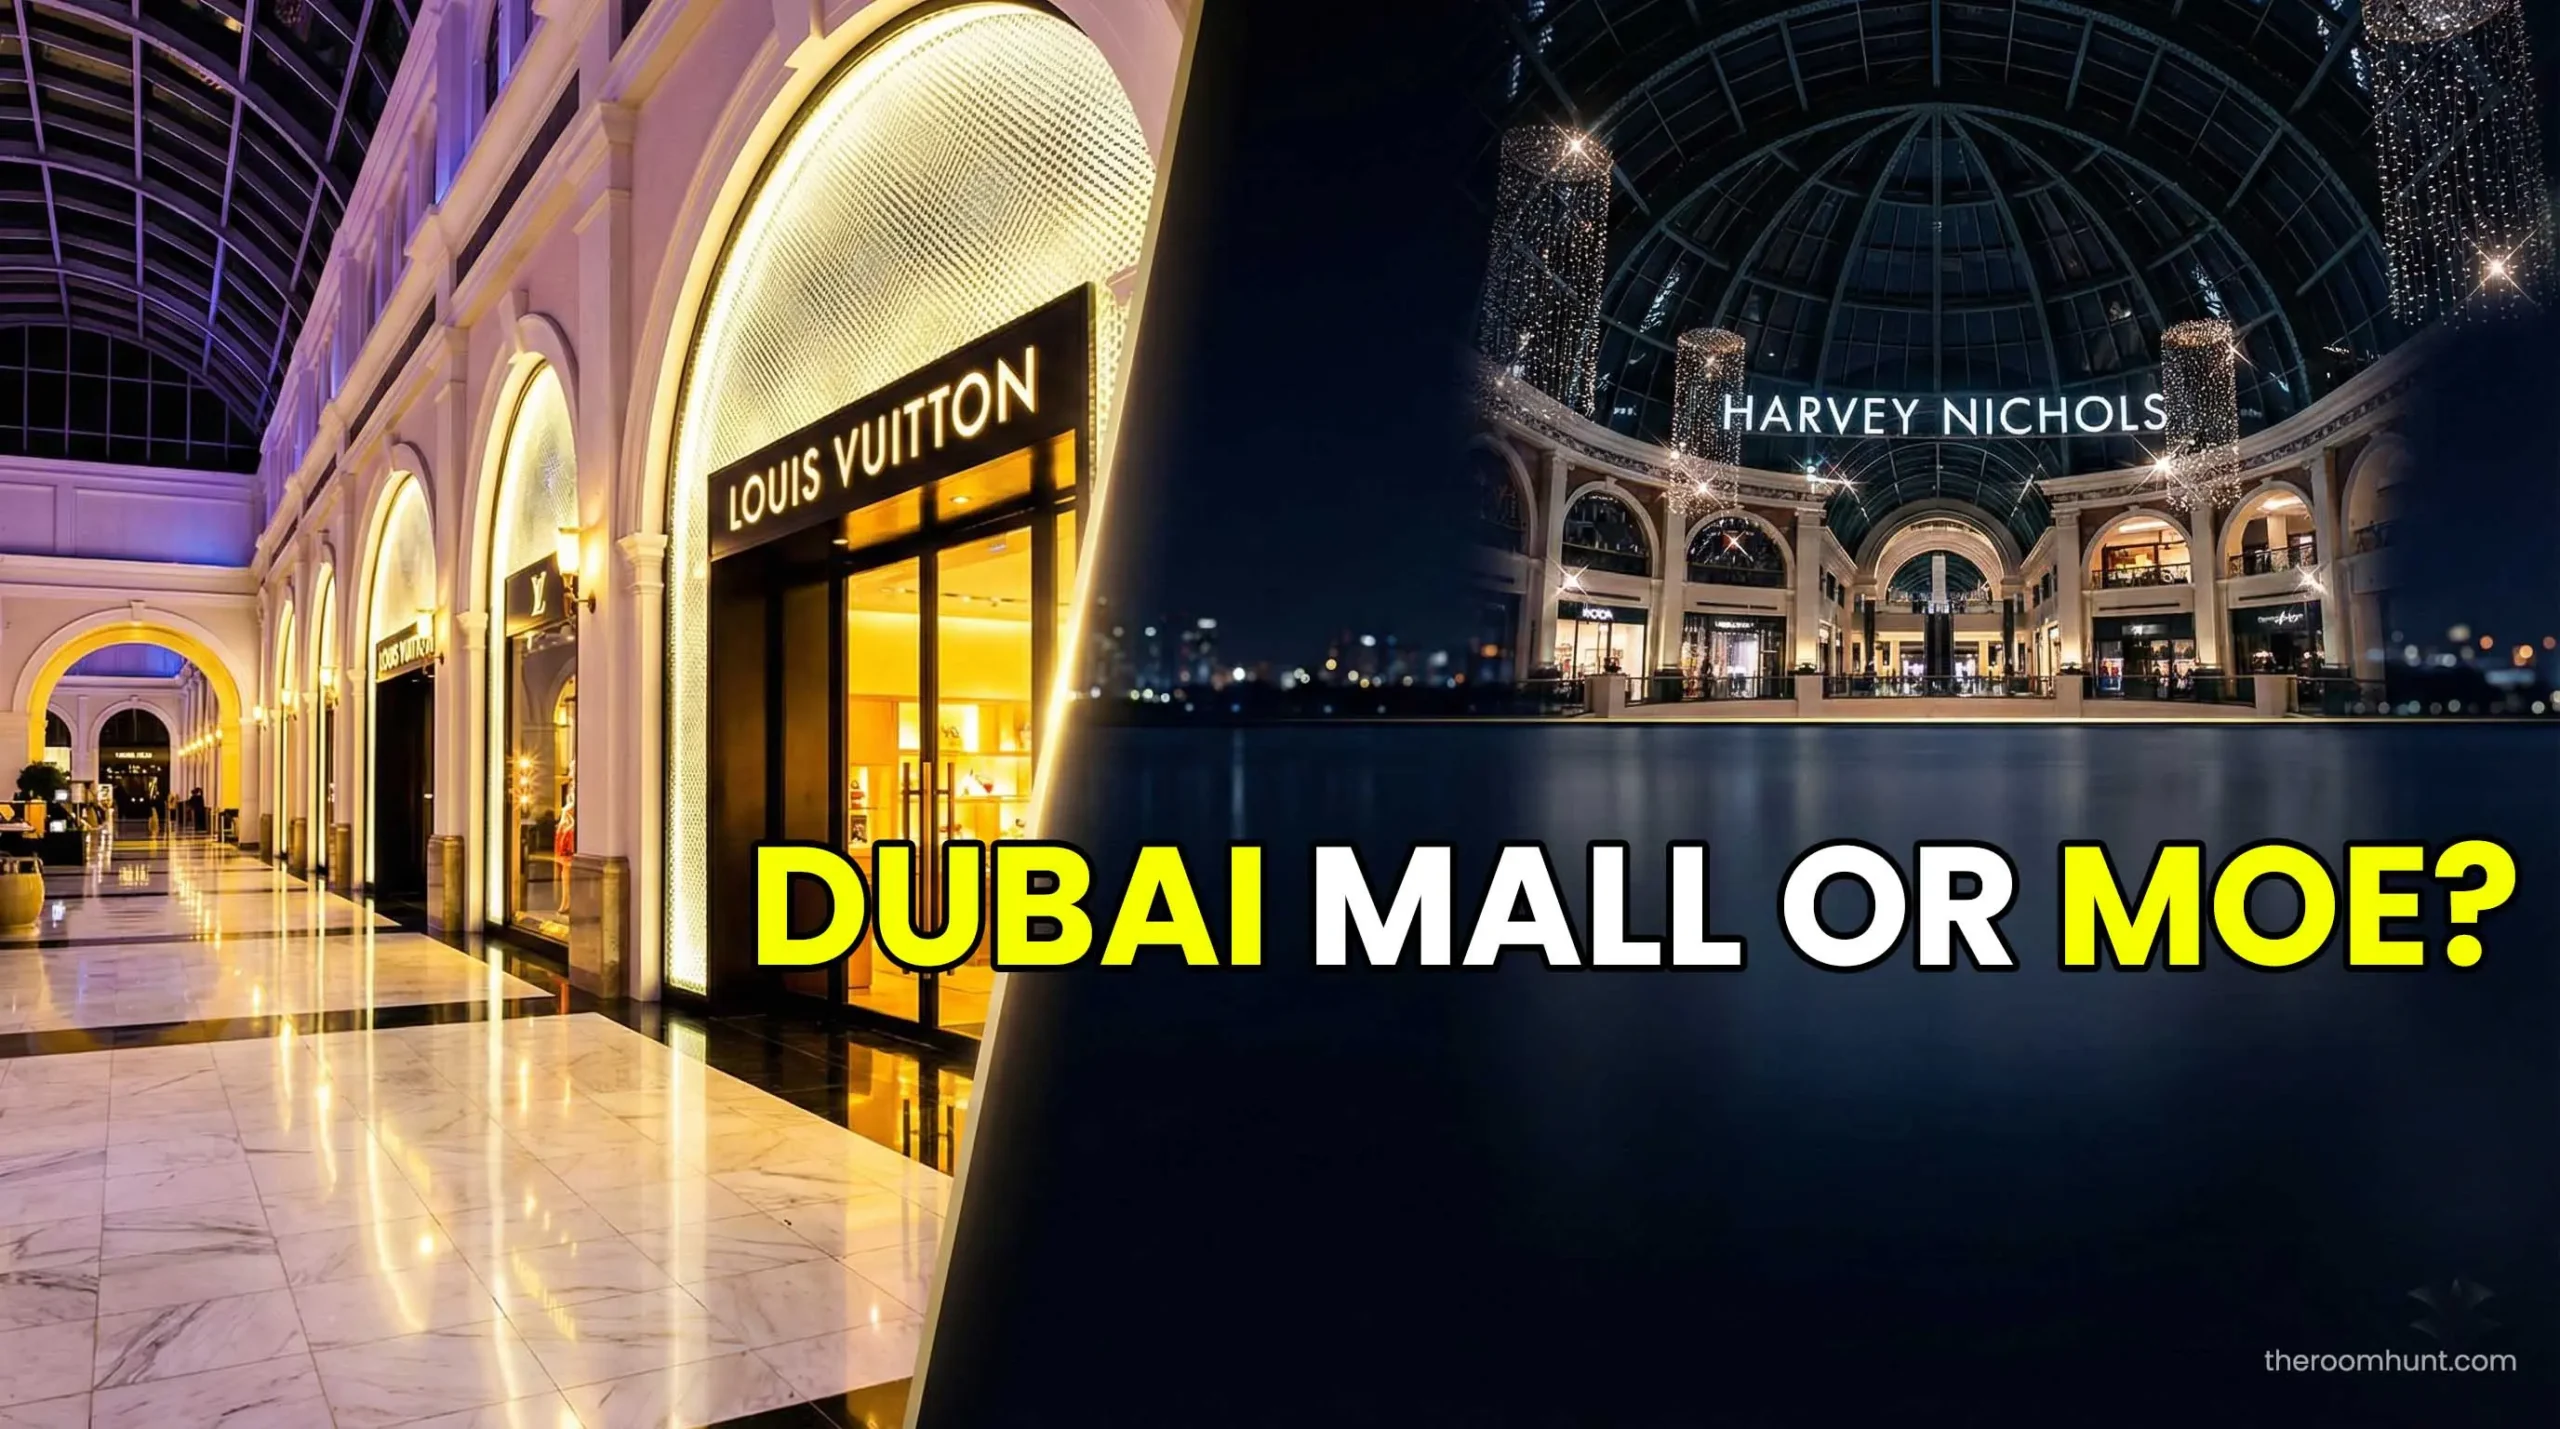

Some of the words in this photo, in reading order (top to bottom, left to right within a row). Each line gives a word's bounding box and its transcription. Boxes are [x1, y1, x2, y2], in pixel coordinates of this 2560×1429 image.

[729, 446, 821, 531] LOUIS
[834, 346, 1037, 488] VUITTON
[1722, 393, 1920, 436] HARVEY
[1942, 392, 2170, 437] NICHOLS
